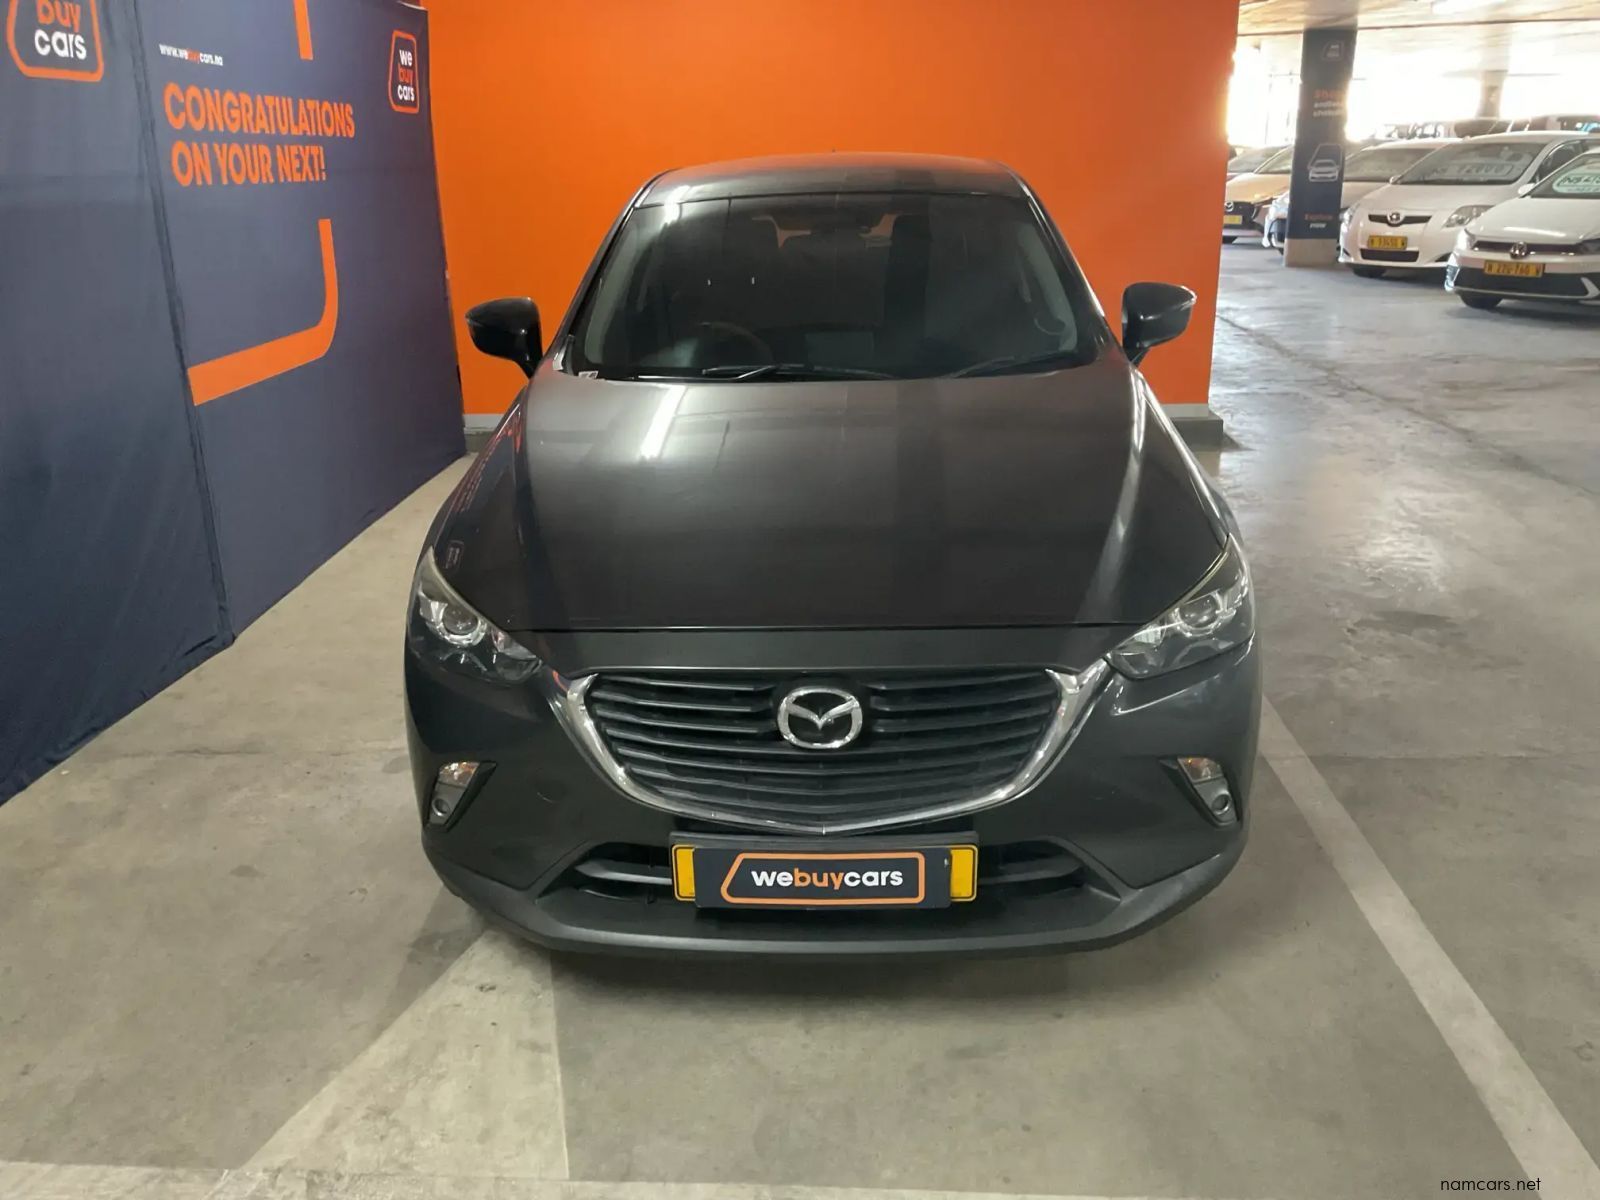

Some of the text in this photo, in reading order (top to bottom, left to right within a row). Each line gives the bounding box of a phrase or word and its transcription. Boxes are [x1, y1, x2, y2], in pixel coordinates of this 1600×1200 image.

[36, 0, 81, 33] buy
[34, 29, 87, 60] cars
[399, 49, 413, 67] we
[398, 63, 414, 86] buy
[397, 84, 415, 102] cars
[163, 82, 355, 138] CONGRATULATIONS
[171, 140, 327, 187] ON YOUR NEXT!
[751, 867, 904, 890] webuycars
